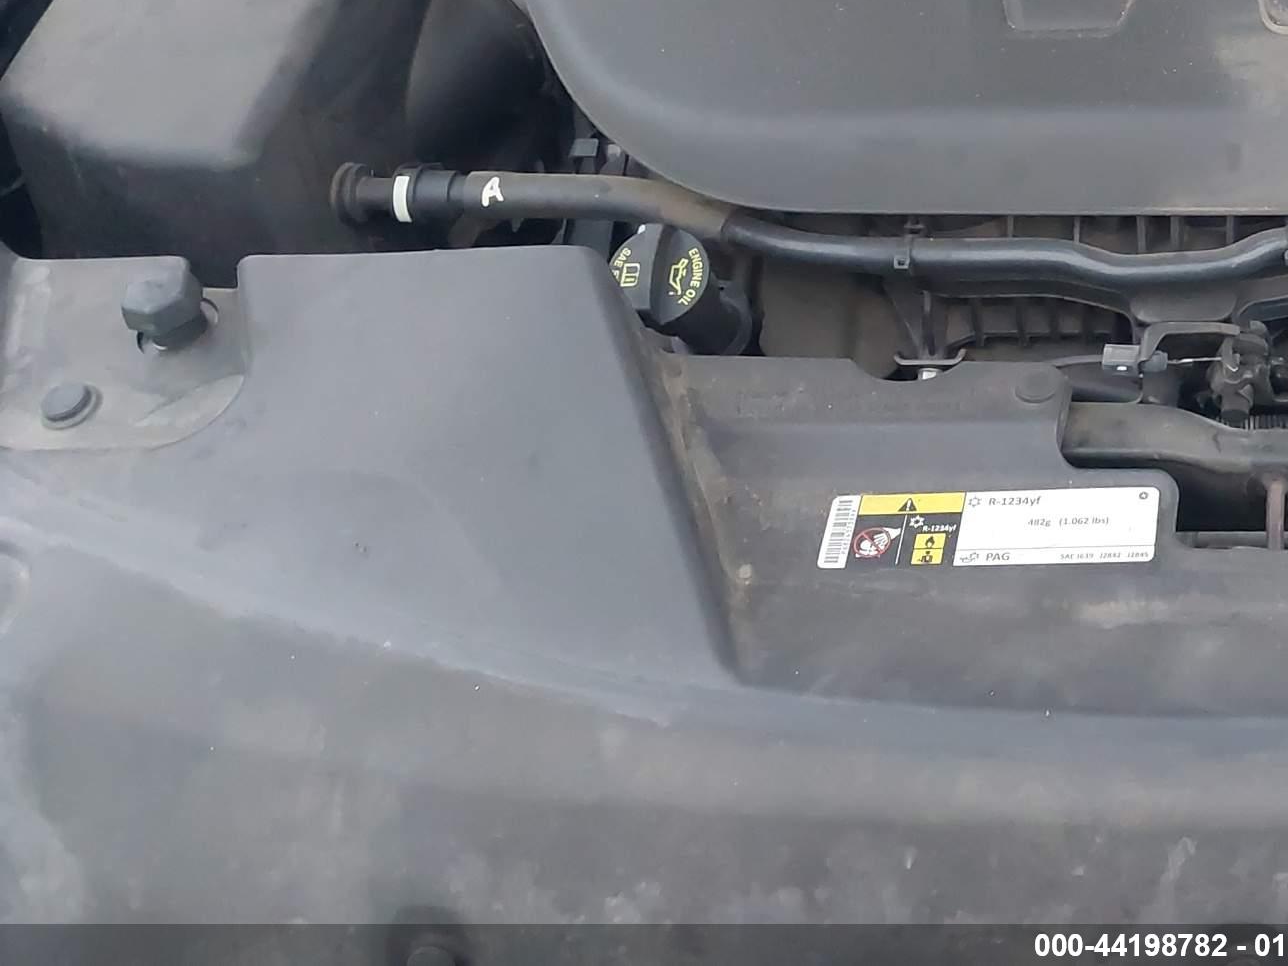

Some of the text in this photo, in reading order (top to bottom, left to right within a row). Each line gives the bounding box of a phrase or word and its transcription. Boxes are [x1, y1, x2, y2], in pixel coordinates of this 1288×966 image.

[481, 176, 504, 207] A
[614, 247, 632, 268] SAE
[677, 247, 704, 306] ENGINE OIL
[988, 496, 1042, 506] R-1234yf
[1058, 516, 1089, 527] (1.062
[1091, 516, 1110, 526] lbs)
[922, 524, 957, 533] R-1234yf
[985, 552, 1010, 561] PAG
